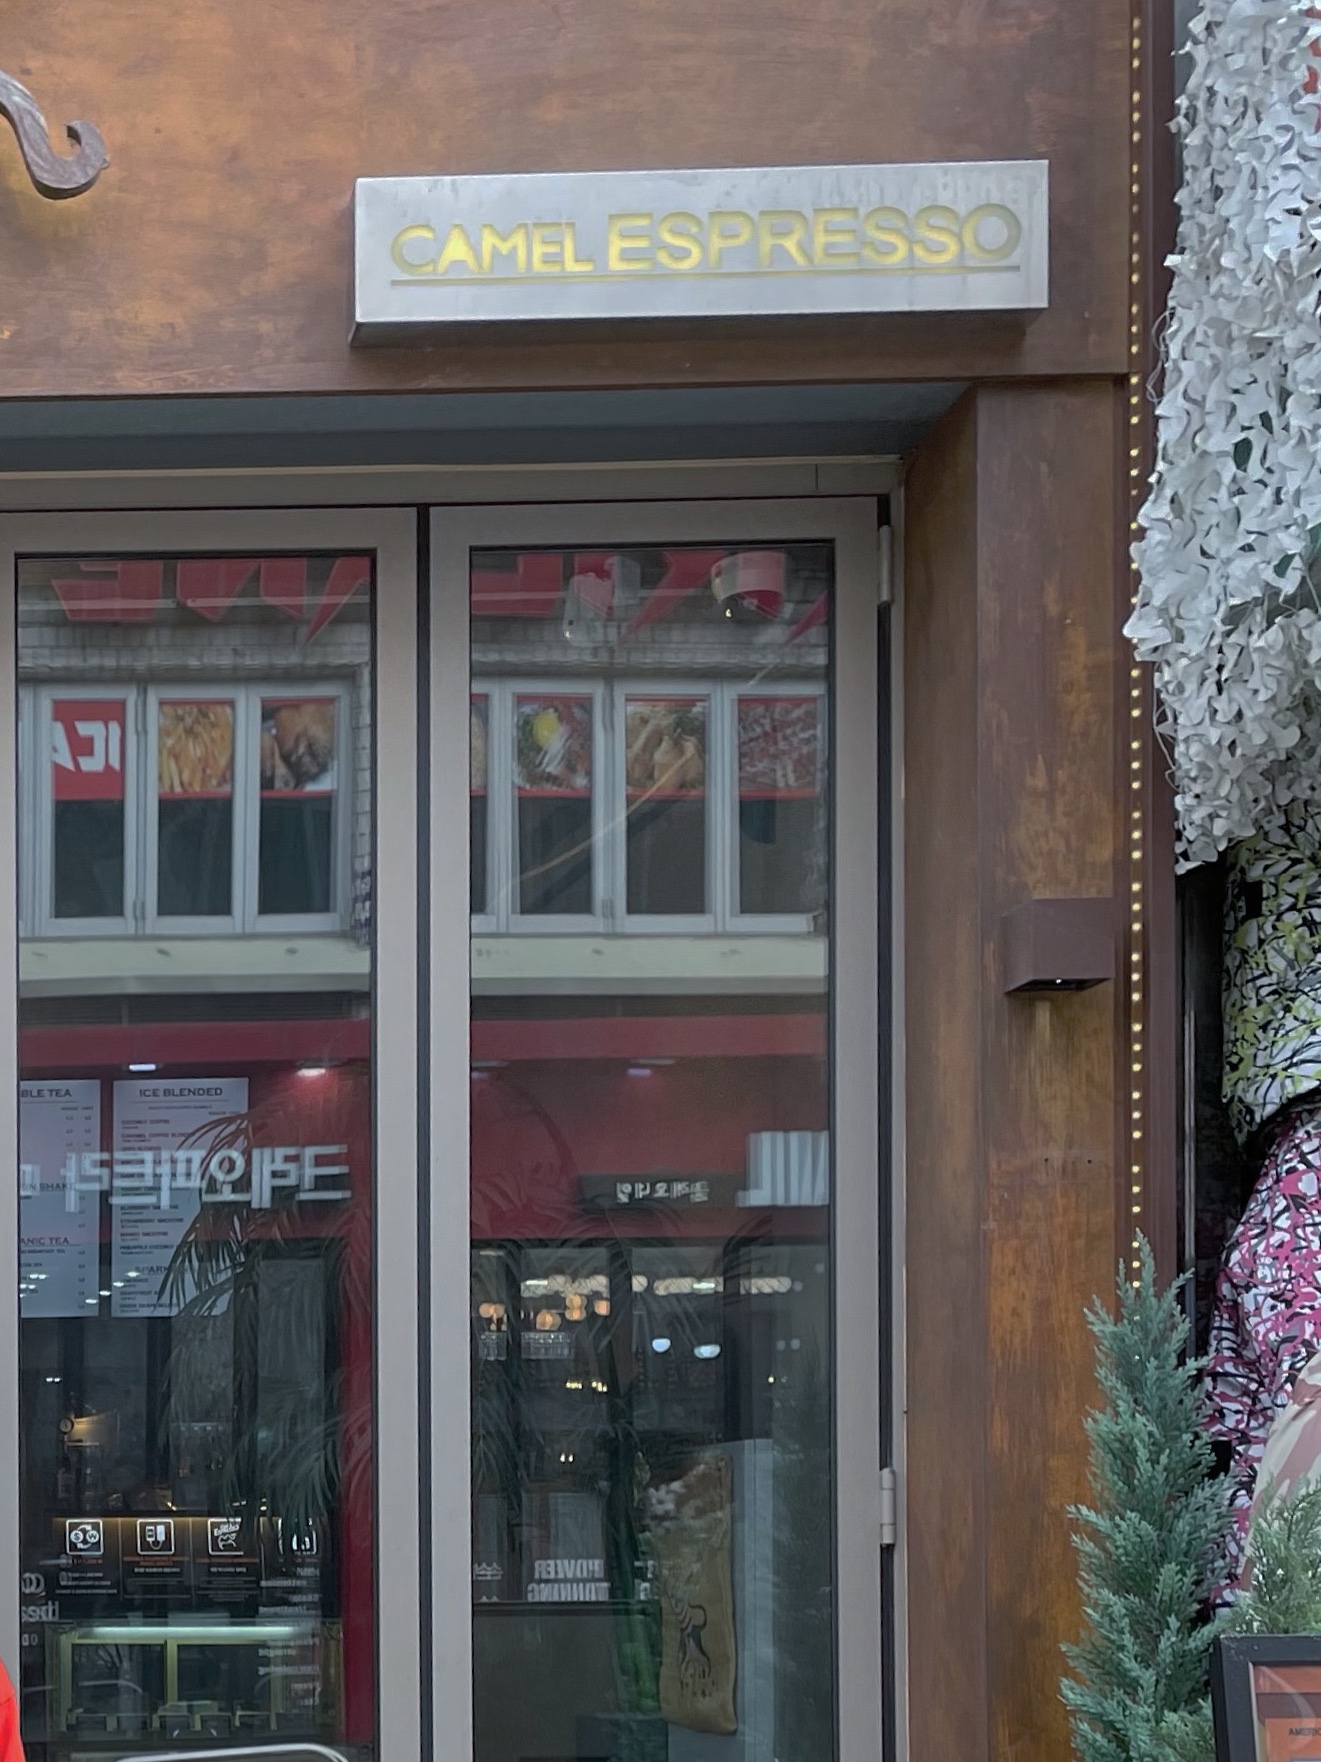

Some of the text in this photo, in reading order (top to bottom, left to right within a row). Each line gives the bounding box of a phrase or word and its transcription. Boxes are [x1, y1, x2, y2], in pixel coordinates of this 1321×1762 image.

[390, 203, 1022, 276] CAMEL ESPRESSO
[47, 1088, 72, 1098] TEA
[139, 1086, 223, 1098] ICE BLENDED
[49, 1236, 70, 1245] TEA
